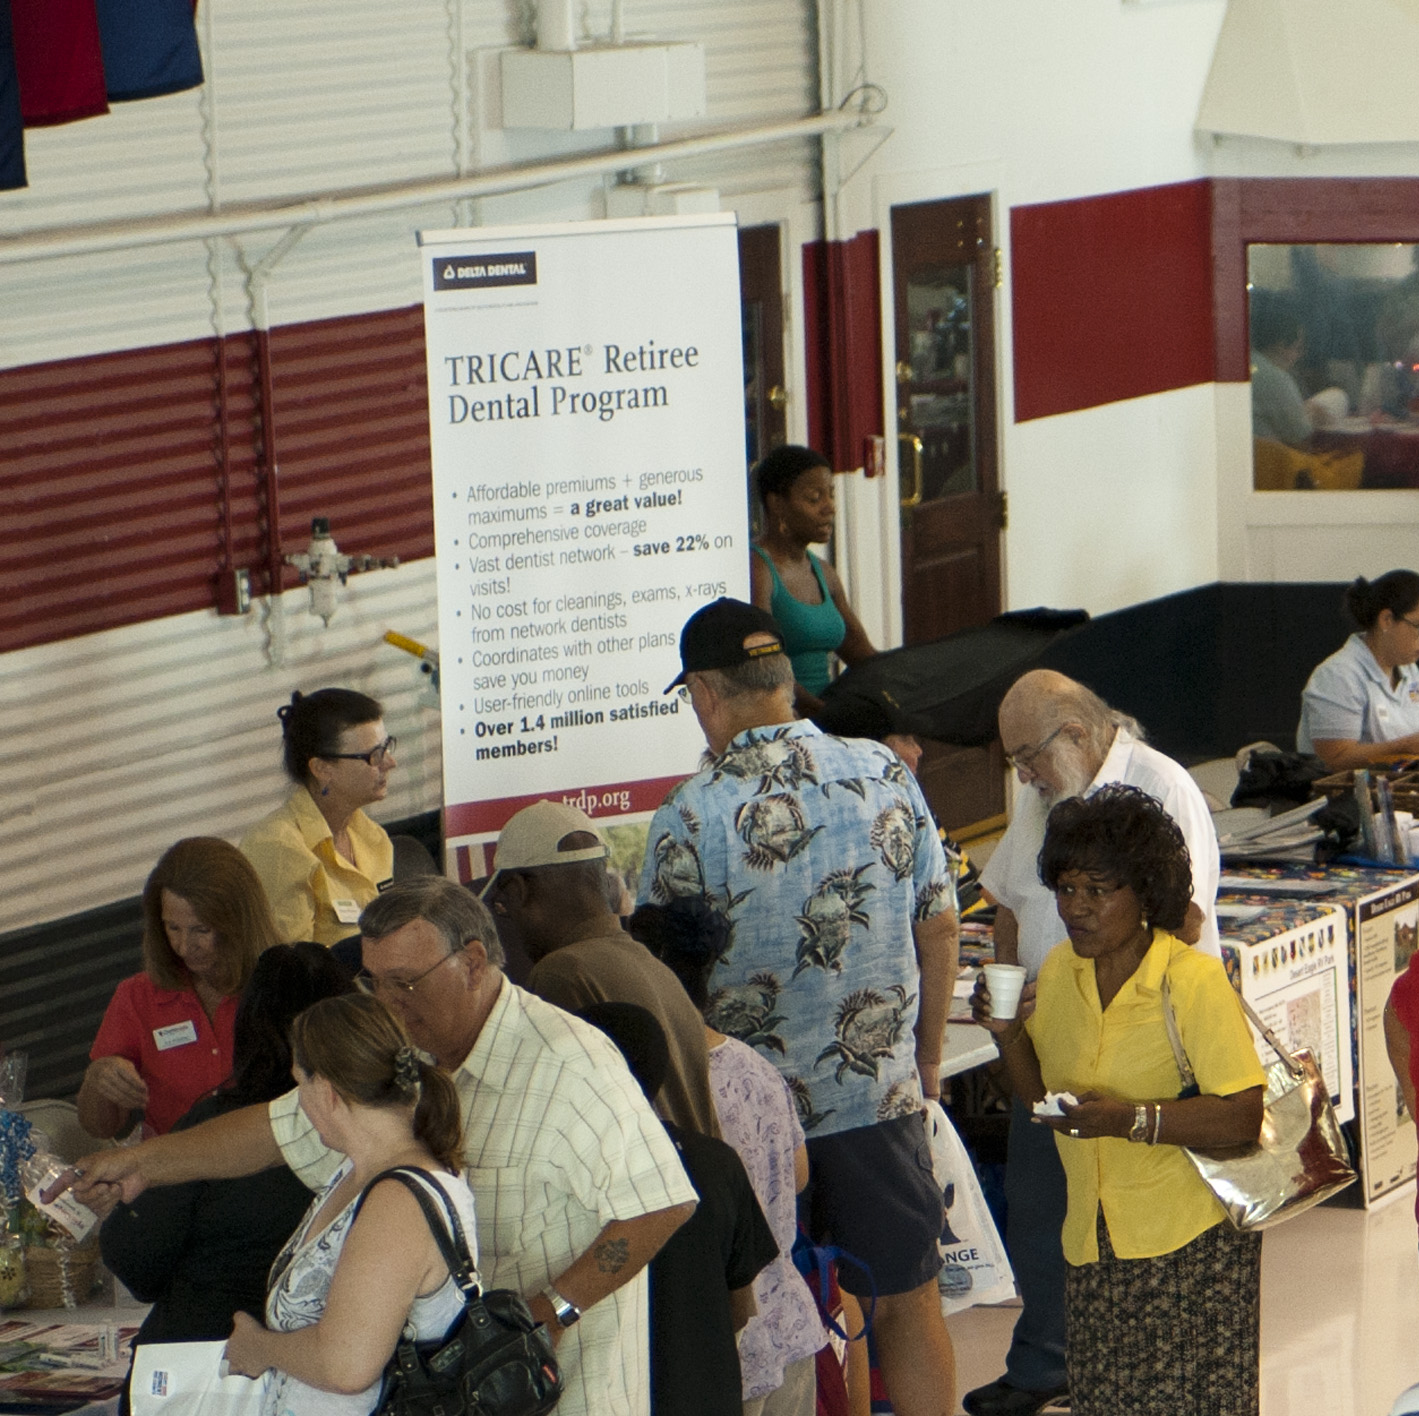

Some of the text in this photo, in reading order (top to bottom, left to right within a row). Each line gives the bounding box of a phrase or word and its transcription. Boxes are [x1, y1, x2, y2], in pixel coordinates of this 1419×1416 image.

[457, 263, 526, 279] DELTA DENTAL
[603, 339, 700, 375] Retiree
[448, 383, 669, 425] Dental Program
[467, 480, 542, 503] Affordable
[546, 474, 617, 499] premiums
[638, 467, 704, 491] generous
[467, 504, 548, 526] maximums
[570, 501, 581, 517] a
[585, 494, 630, 518] great
[634, 489, 683, 510] value!
[468, 518, 648, 551] Comprehensive coverage
[469, 555, 501, 574] Vast
[505, 549, 555, 570] dentist
[559, 543, 616, 566] network
[632, 539, 671, 557] save
[674, 533, 710, 553] 22%
[713, 534, 734, 550] on
[469, 576, 512, 597] visits!
[471, 580, 728, 621] No cost for cleanings, exams, x-rays
[471, 612, 628, 644] from network dentists
[472, 630, 676, 668] Coordinates with other plans
[473, 663, 590, 690] save you money
[474, 679, 650, 714] User-friendly online tools
[474, 698, 680, 738] Over 1.4 million satisfied
[475, 735, 559, 760] members!
[944, 1247, 979, 1264] NGE
